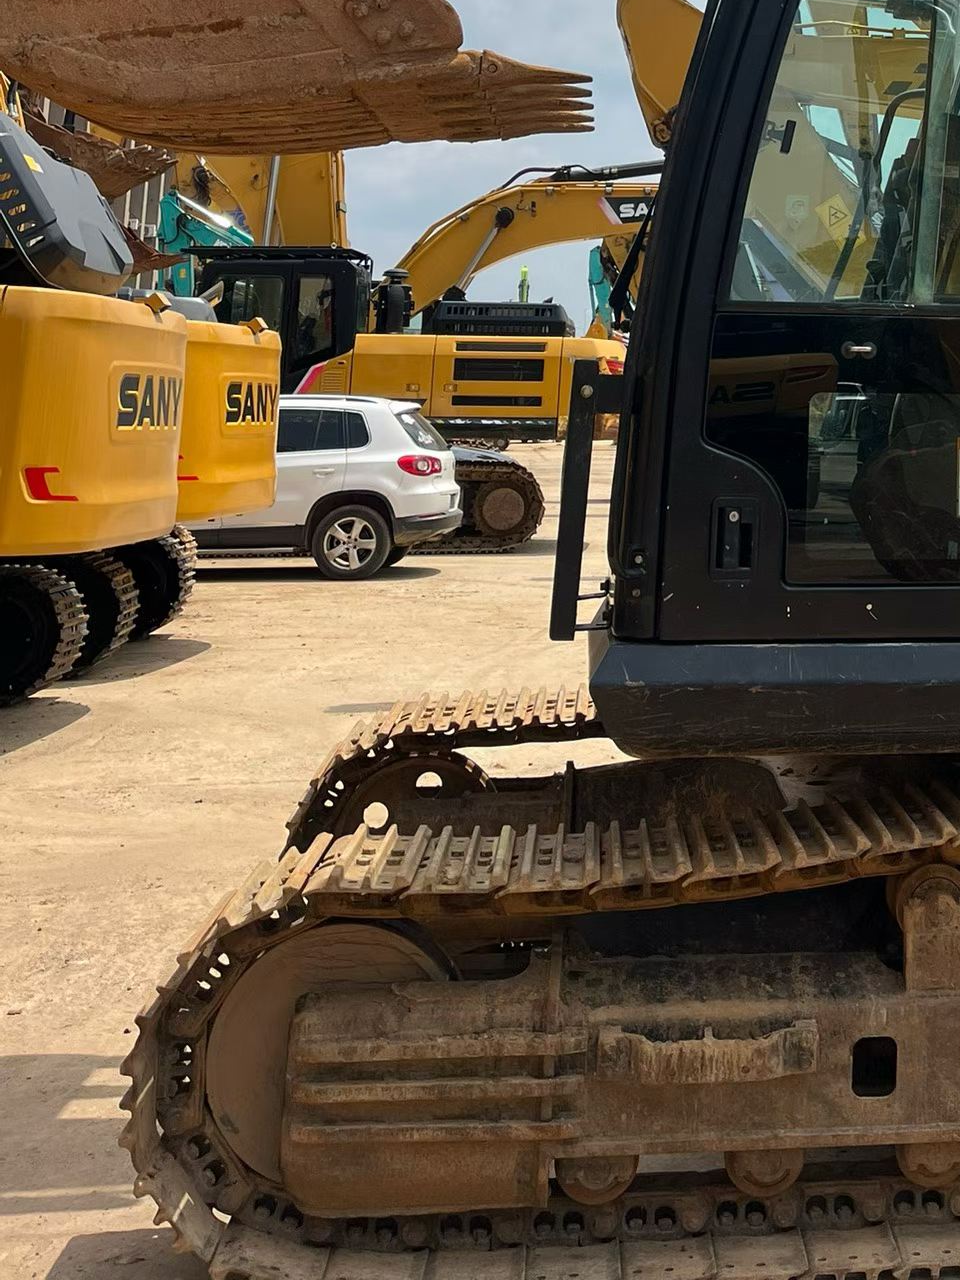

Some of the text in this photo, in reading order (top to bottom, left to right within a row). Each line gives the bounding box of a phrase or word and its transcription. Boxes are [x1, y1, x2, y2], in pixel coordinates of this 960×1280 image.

[619, 202, 655, 218] SA
[116, 373, 183, 430] SANY
[225, 381, 278, 426] SANY
